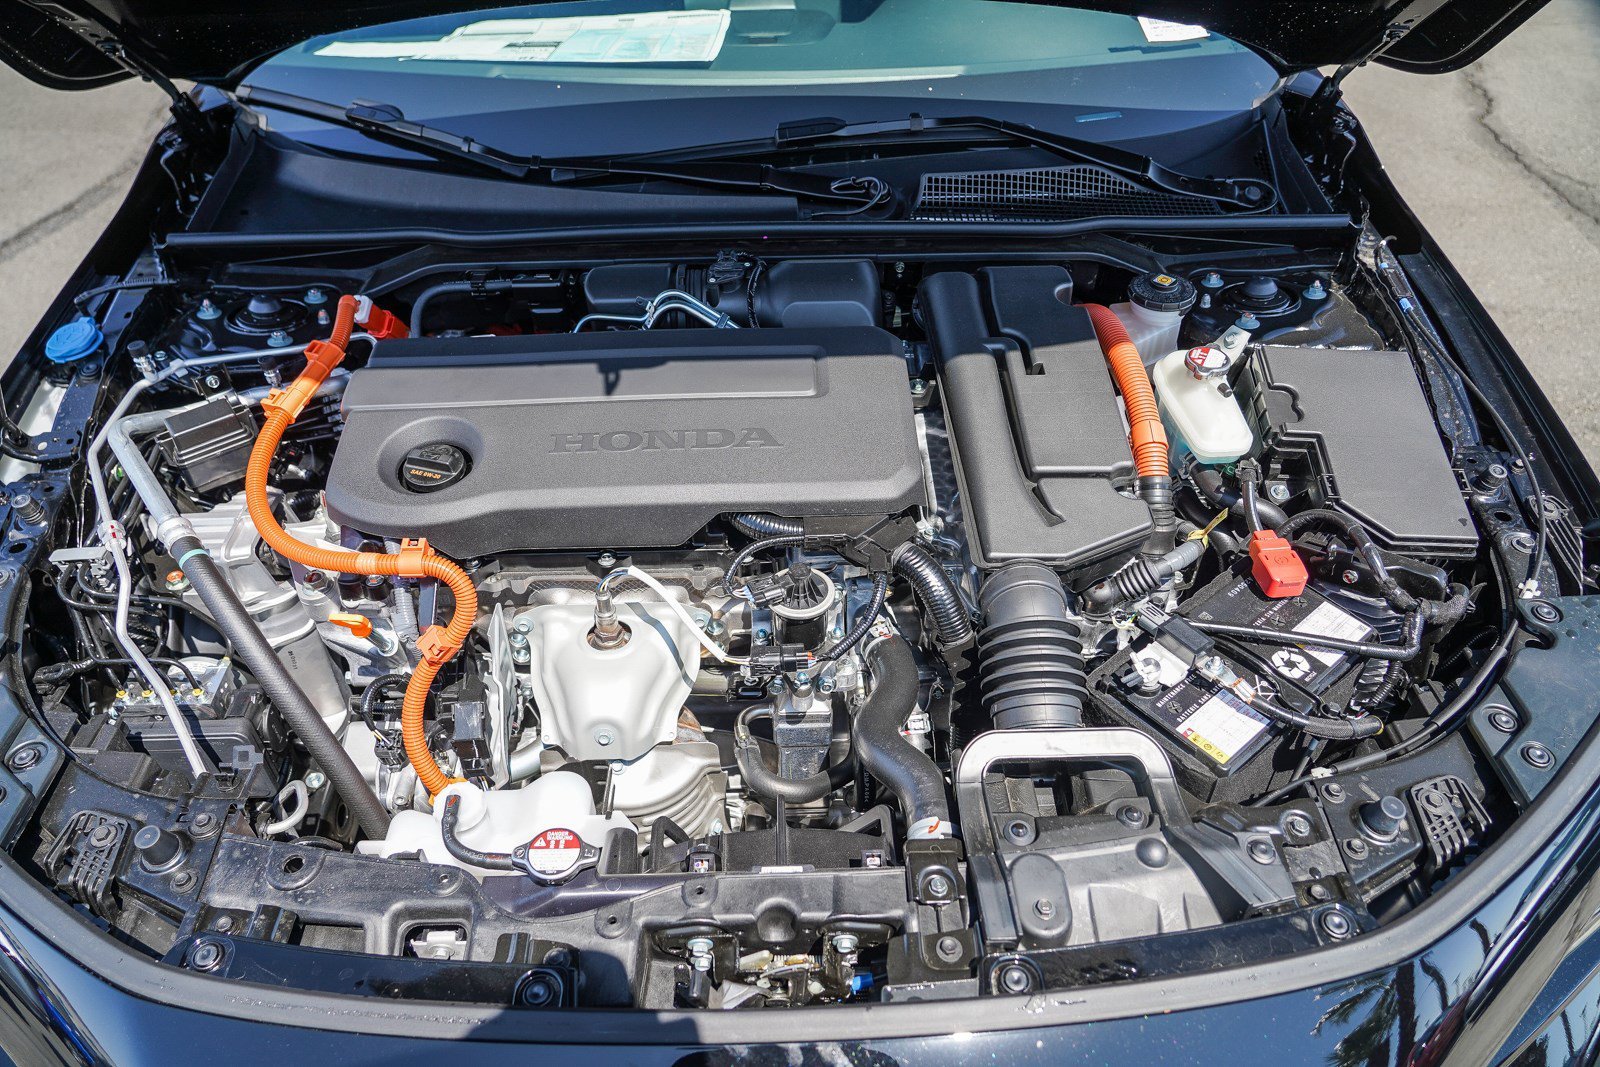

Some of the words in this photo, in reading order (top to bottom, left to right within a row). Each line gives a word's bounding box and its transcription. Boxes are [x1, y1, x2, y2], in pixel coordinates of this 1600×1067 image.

[549, 427, 783, 454] HONDA
[1155, 682, 1186, 708] MAINTENANCE
[1176, 703, 1200, 724] BATTERIE
